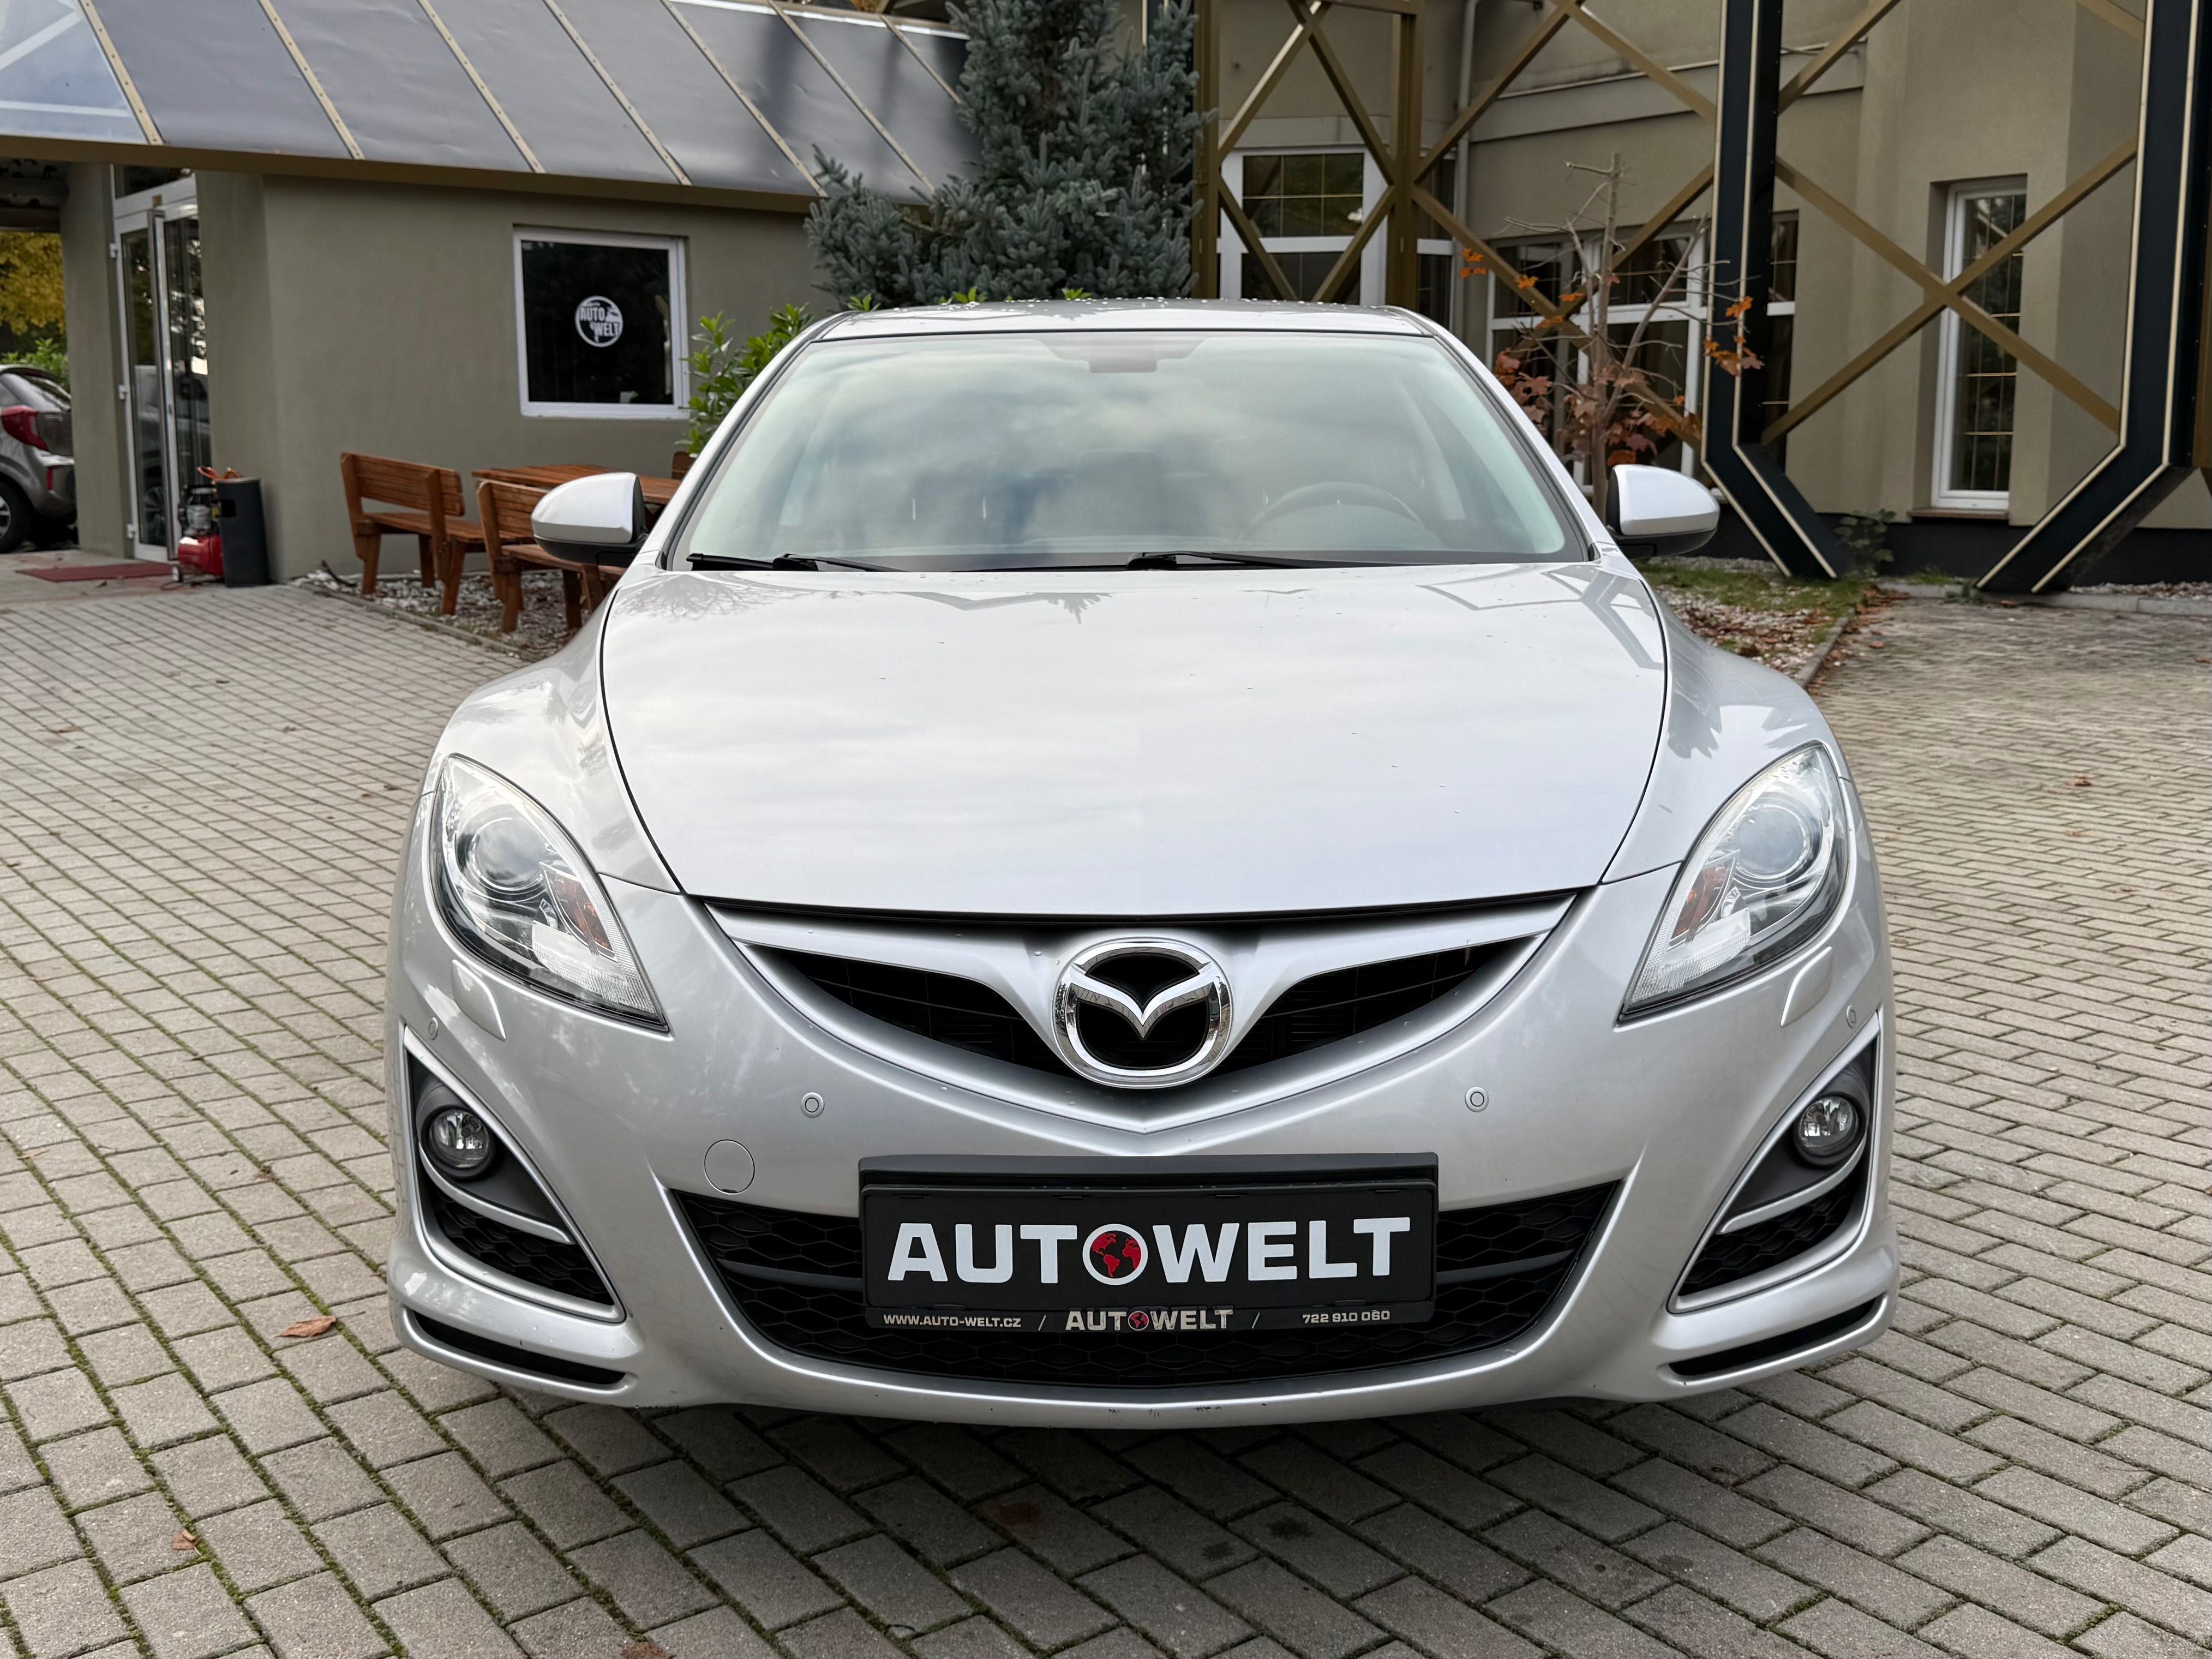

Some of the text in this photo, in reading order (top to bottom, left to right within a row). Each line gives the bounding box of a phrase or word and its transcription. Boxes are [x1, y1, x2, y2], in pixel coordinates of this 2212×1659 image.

[580, 307, 606, 321] AUTO
[594, 322, 620, 337] WELT
[883, 1314, 1021, 1327] WWW.AUTO-WELT.CZ
[1302, 1313, 1329, 1323] 722
[1332, 1312, 1358, 1322] 910
[1361, 1310, 1390, 1321] 060
